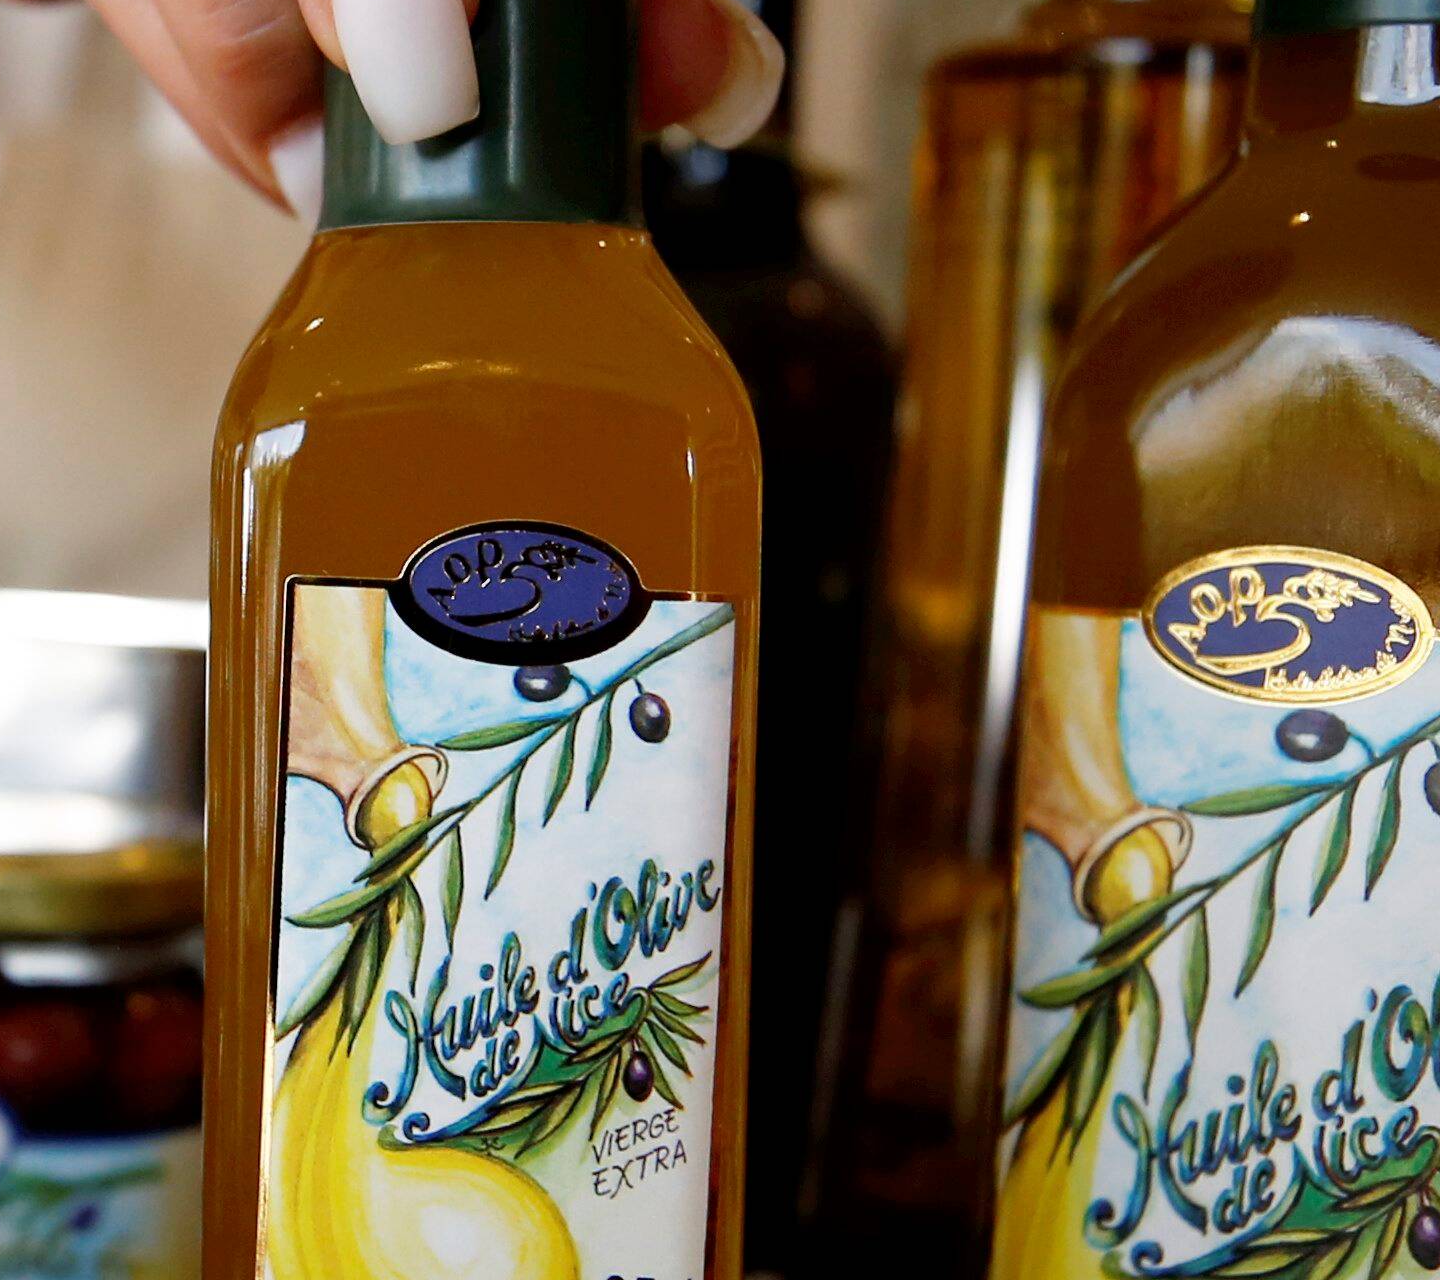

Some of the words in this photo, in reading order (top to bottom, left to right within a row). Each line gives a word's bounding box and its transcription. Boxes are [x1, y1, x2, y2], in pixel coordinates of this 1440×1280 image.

[362, 931, 540, 1124] Huile
[548, 858, 722, 988] d'Olive
[470, 1030, 521, 1098] de
[590, 1108, 680, 1164] VIERGE
[592, 1139, 688, 1198] EXTRA
[1084, 1039, 1301, 1248] Huile
[1214, 1167, 1273, 1236] de
